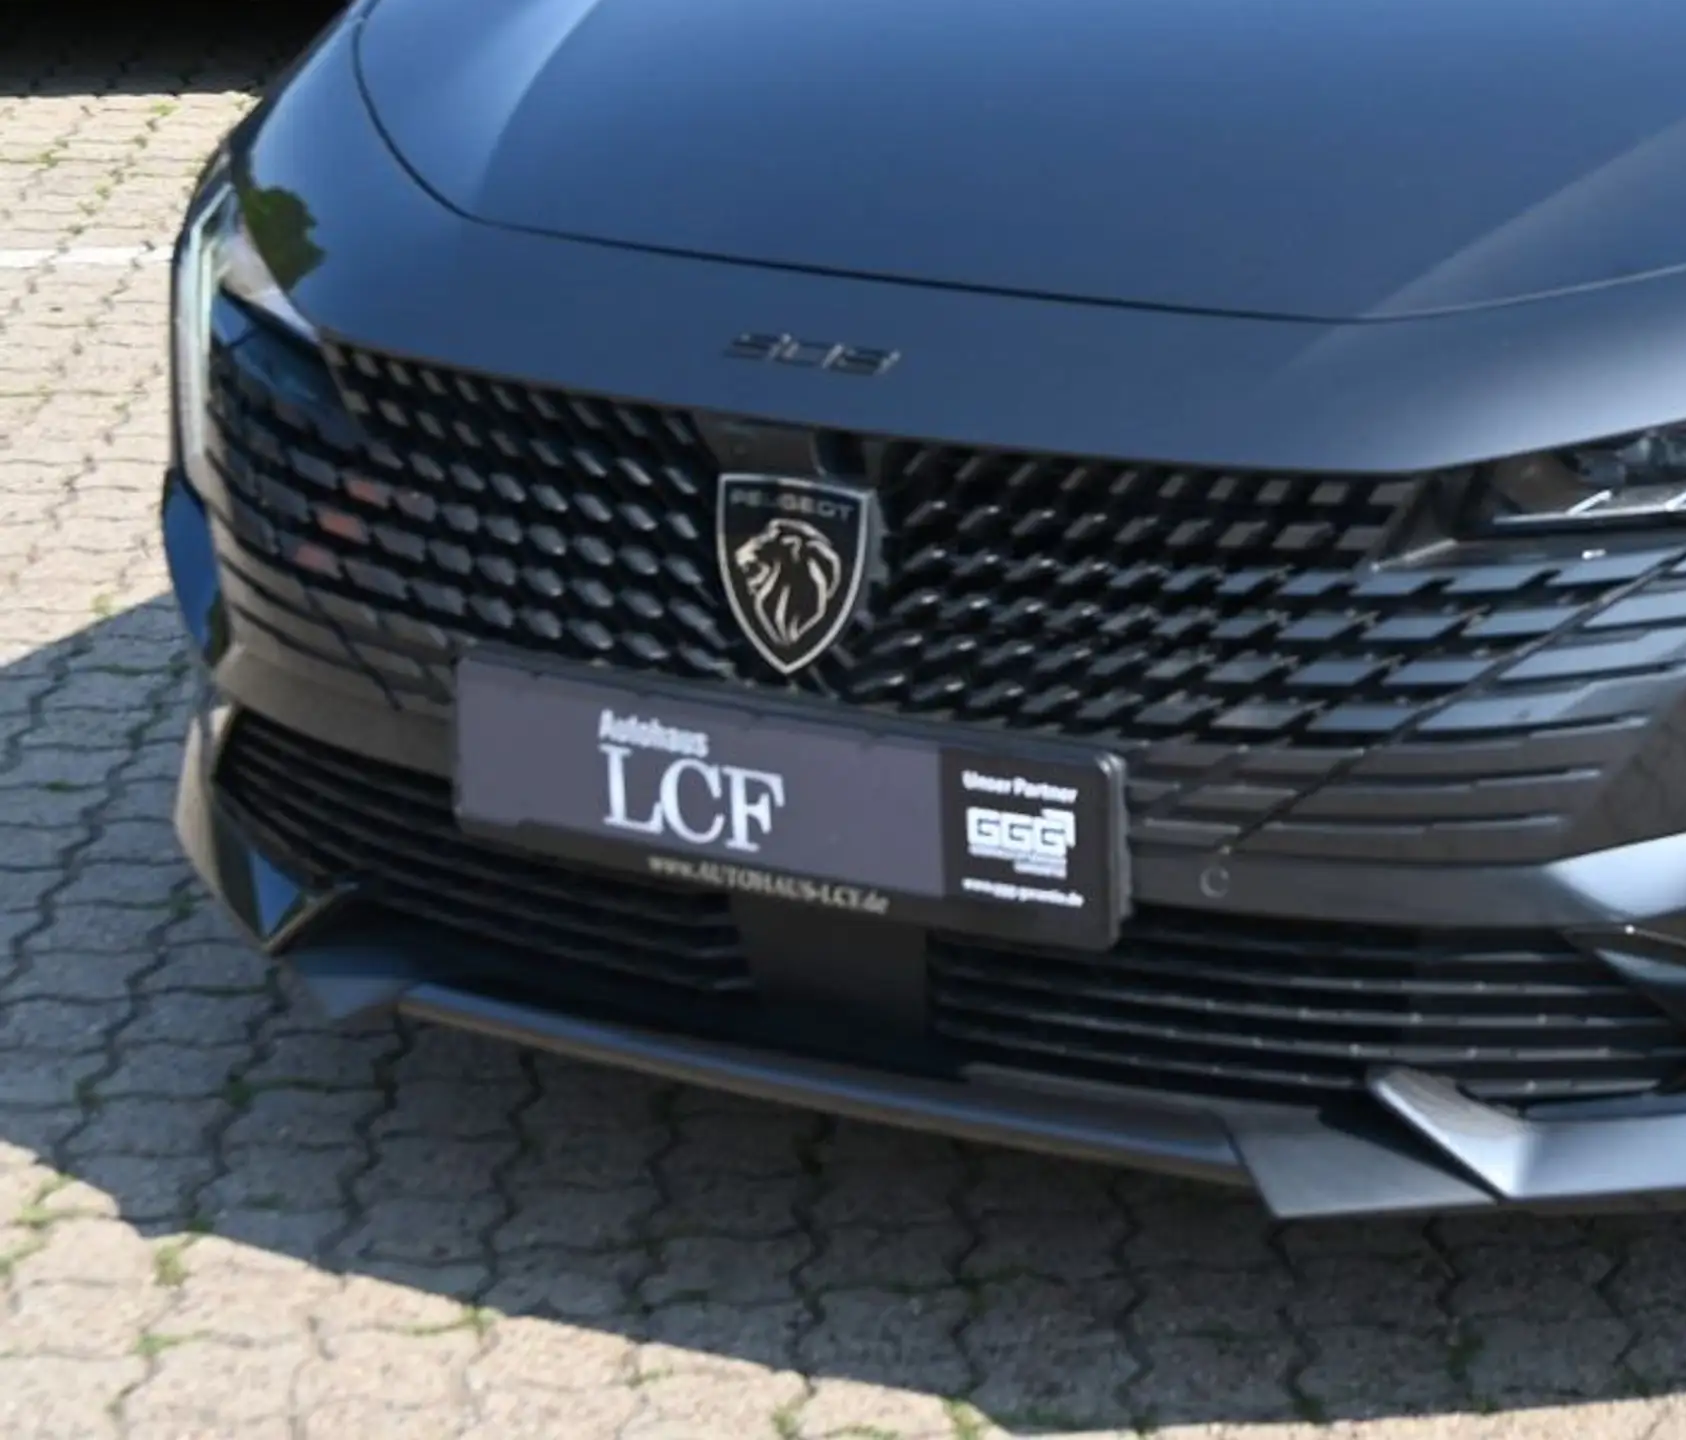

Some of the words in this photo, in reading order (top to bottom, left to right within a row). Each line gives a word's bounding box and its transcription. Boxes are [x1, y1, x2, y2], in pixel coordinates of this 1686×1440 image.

[599, 709, 709, 757] Autohaus
[598, 742, 785, 852] LCF
[962, 770, 1012, 795] Unser
[1013, 776, 1079, 804] Partner
[967, 806, 1077, 857] GGG
[648, 856, 890, 915] www.AUTOHAUS-LCF.de
